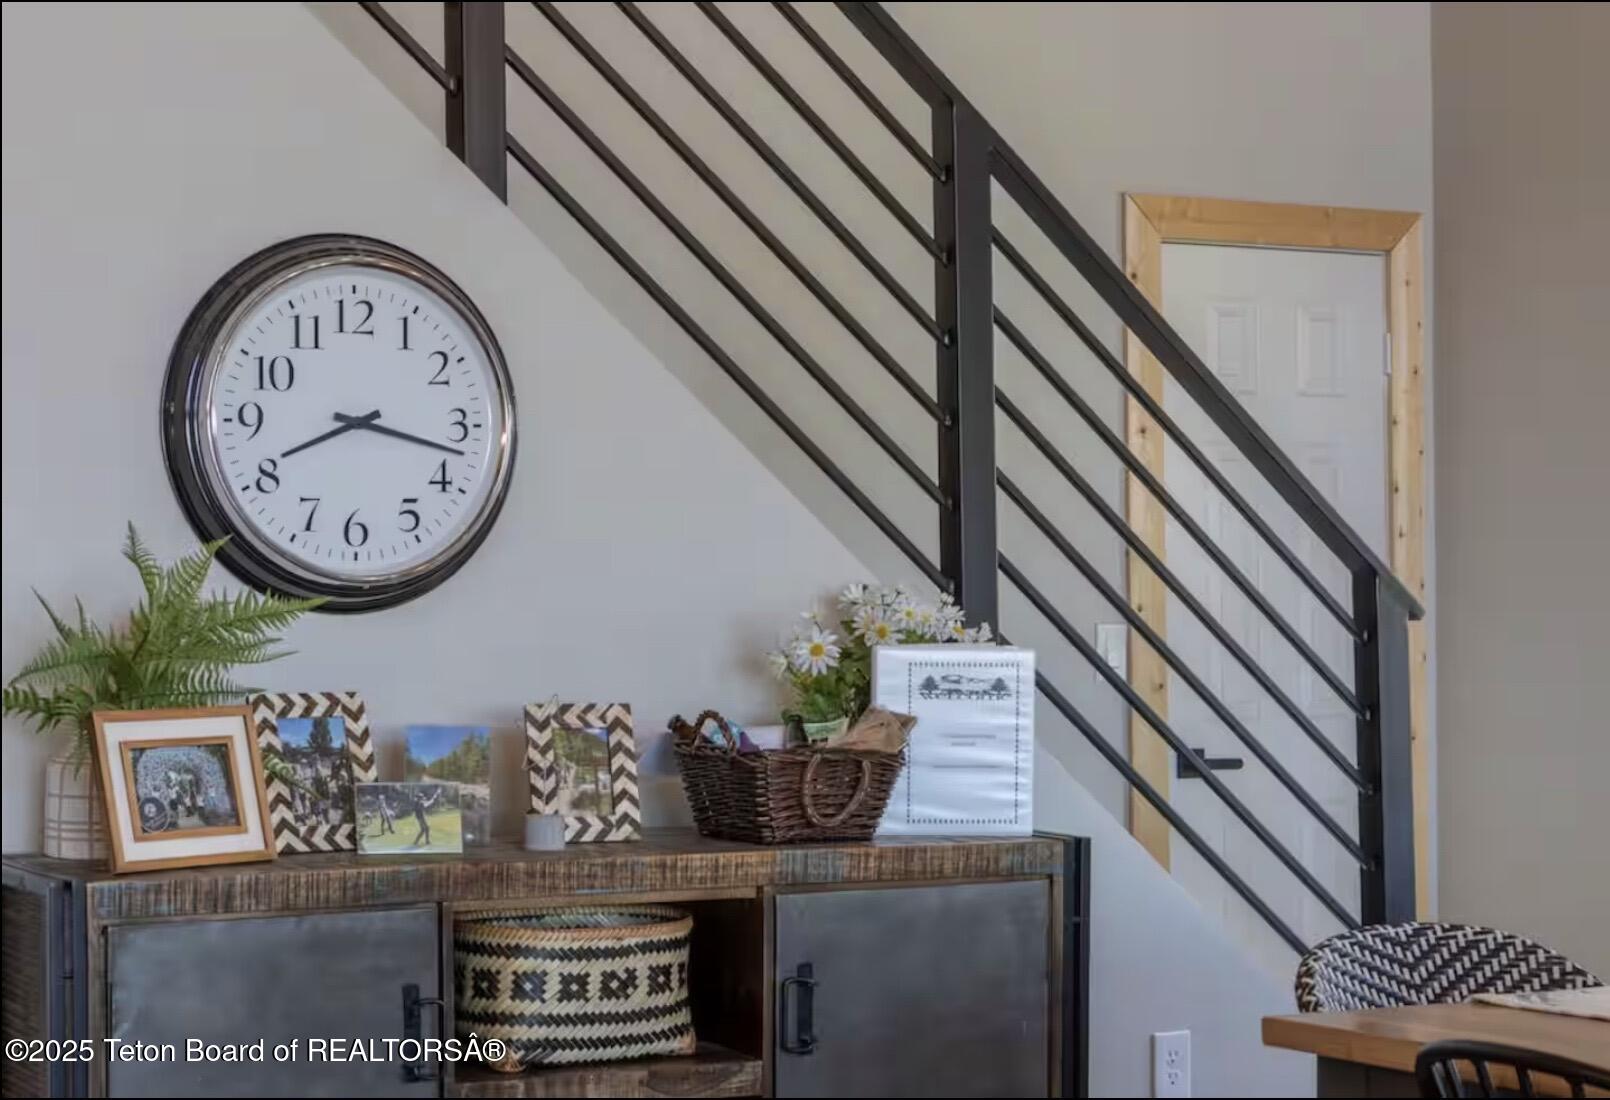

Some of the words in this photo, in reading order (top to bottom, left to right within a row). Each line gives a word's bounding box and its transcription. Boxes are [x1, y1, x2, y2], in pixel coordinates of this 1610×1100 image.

[290, 314, 324, 350] 11
[334, 298, 374, 336] 12
[397, 315, 414, 351] 1
[253, 355, 295, 392] 10
[427, 350, 450, 387] 2
[237, 401, 264, 441] 9
[447, 408, 469, 443] 3
[255, 458, 280, 494] 8
[427, 458, 453, 493] 4
[299, 496, 321, 532] 7
[343, 508, 369, 547] 6
[398, 498, 421, 533] 5
